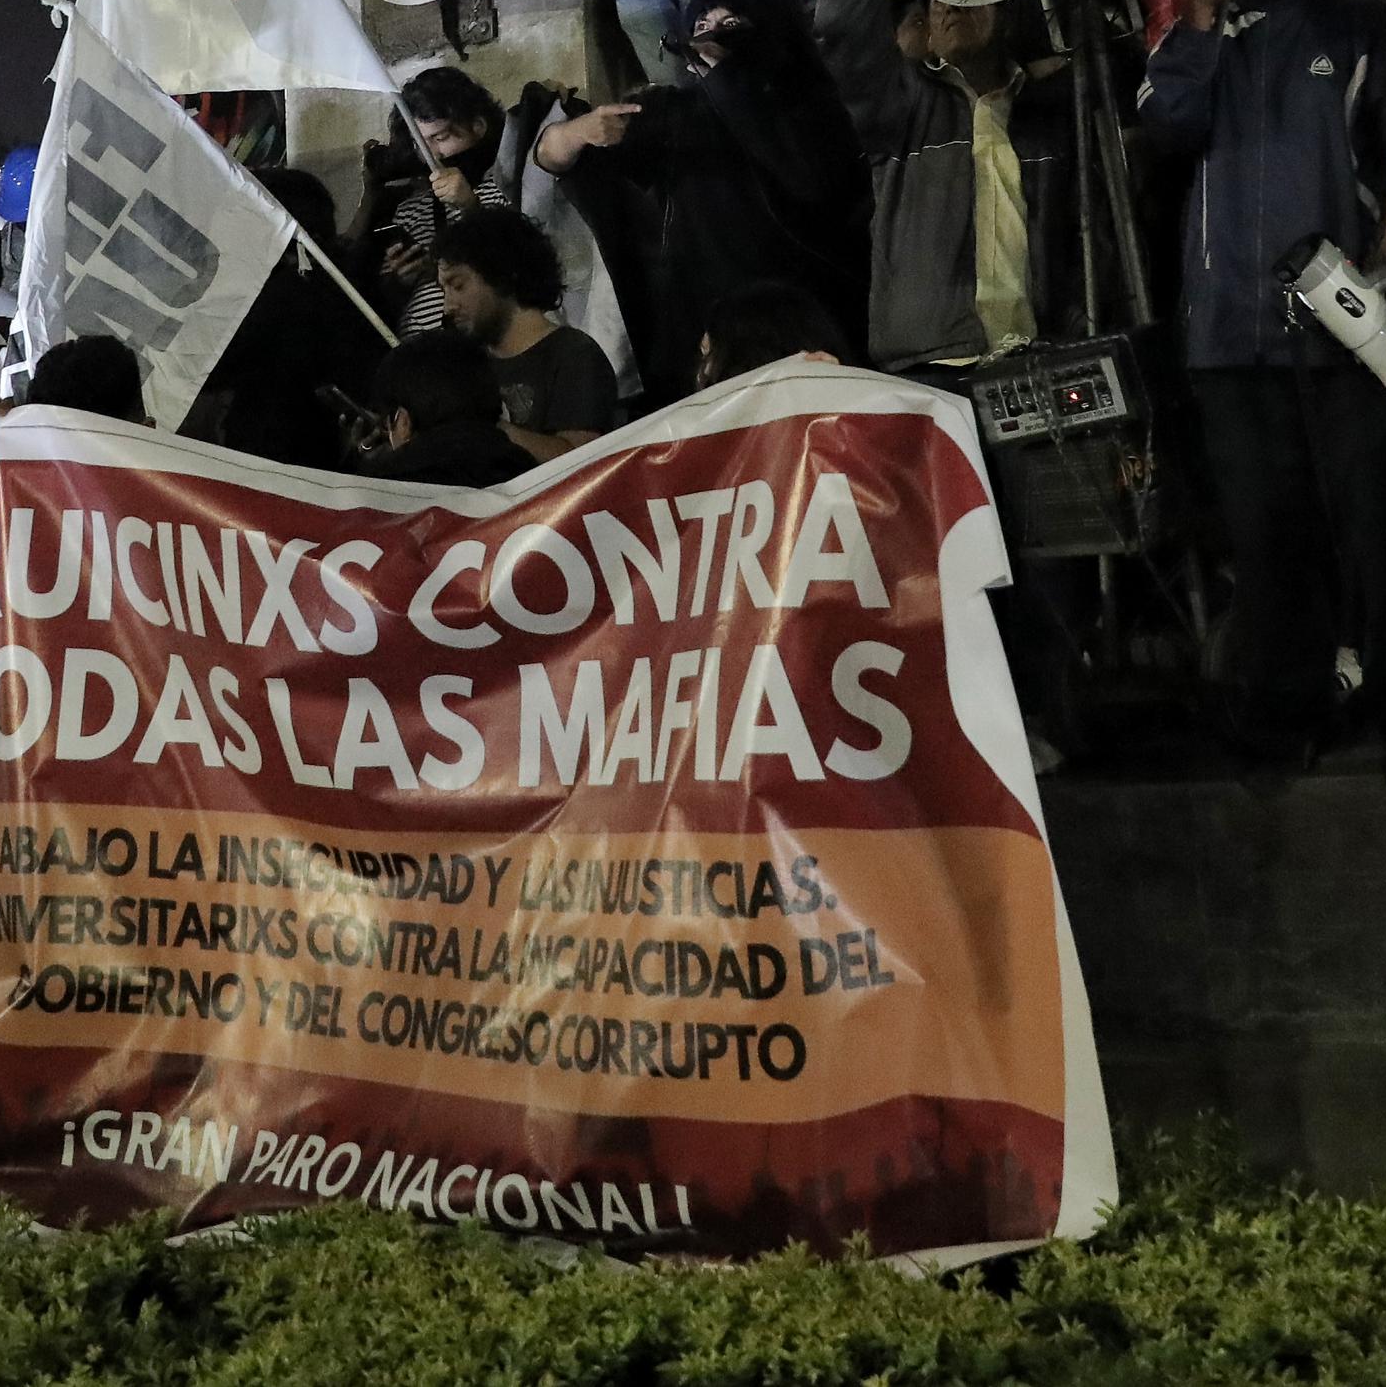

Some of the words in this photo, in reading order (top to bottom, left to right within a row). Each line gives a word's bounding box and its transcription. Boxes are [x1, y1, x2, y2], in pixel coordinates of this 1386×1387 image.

[408, 472, 892, 650] CONTRA
[267, 673, 487, 792] LAS
[517, 639, 913, 791] MAFIAS
[148, 830, 206, 882] LA
[215, 834, 476, 906] INSEGURIDAD
[482, 855, 512, 907] Y
[518, 858, 580, 913] LAS
[305, 911, 462, 977] CONTRA
[468, 927, 511, 985] LA
[516, 932, 788, 1001] INCAPACIDAD
[798, 926, 897, 996] DEL
[254, 975, 283, 1027] Y
[284, 979, 349, 1040] DEL
[356, 987, 552, 1067] CONGRESO
[554, 1013, 808, 1082] CORRUPTO
[60, 1108, 240, 1184] ¡GRAN
[239, 1129, 363, 1198] PARO
